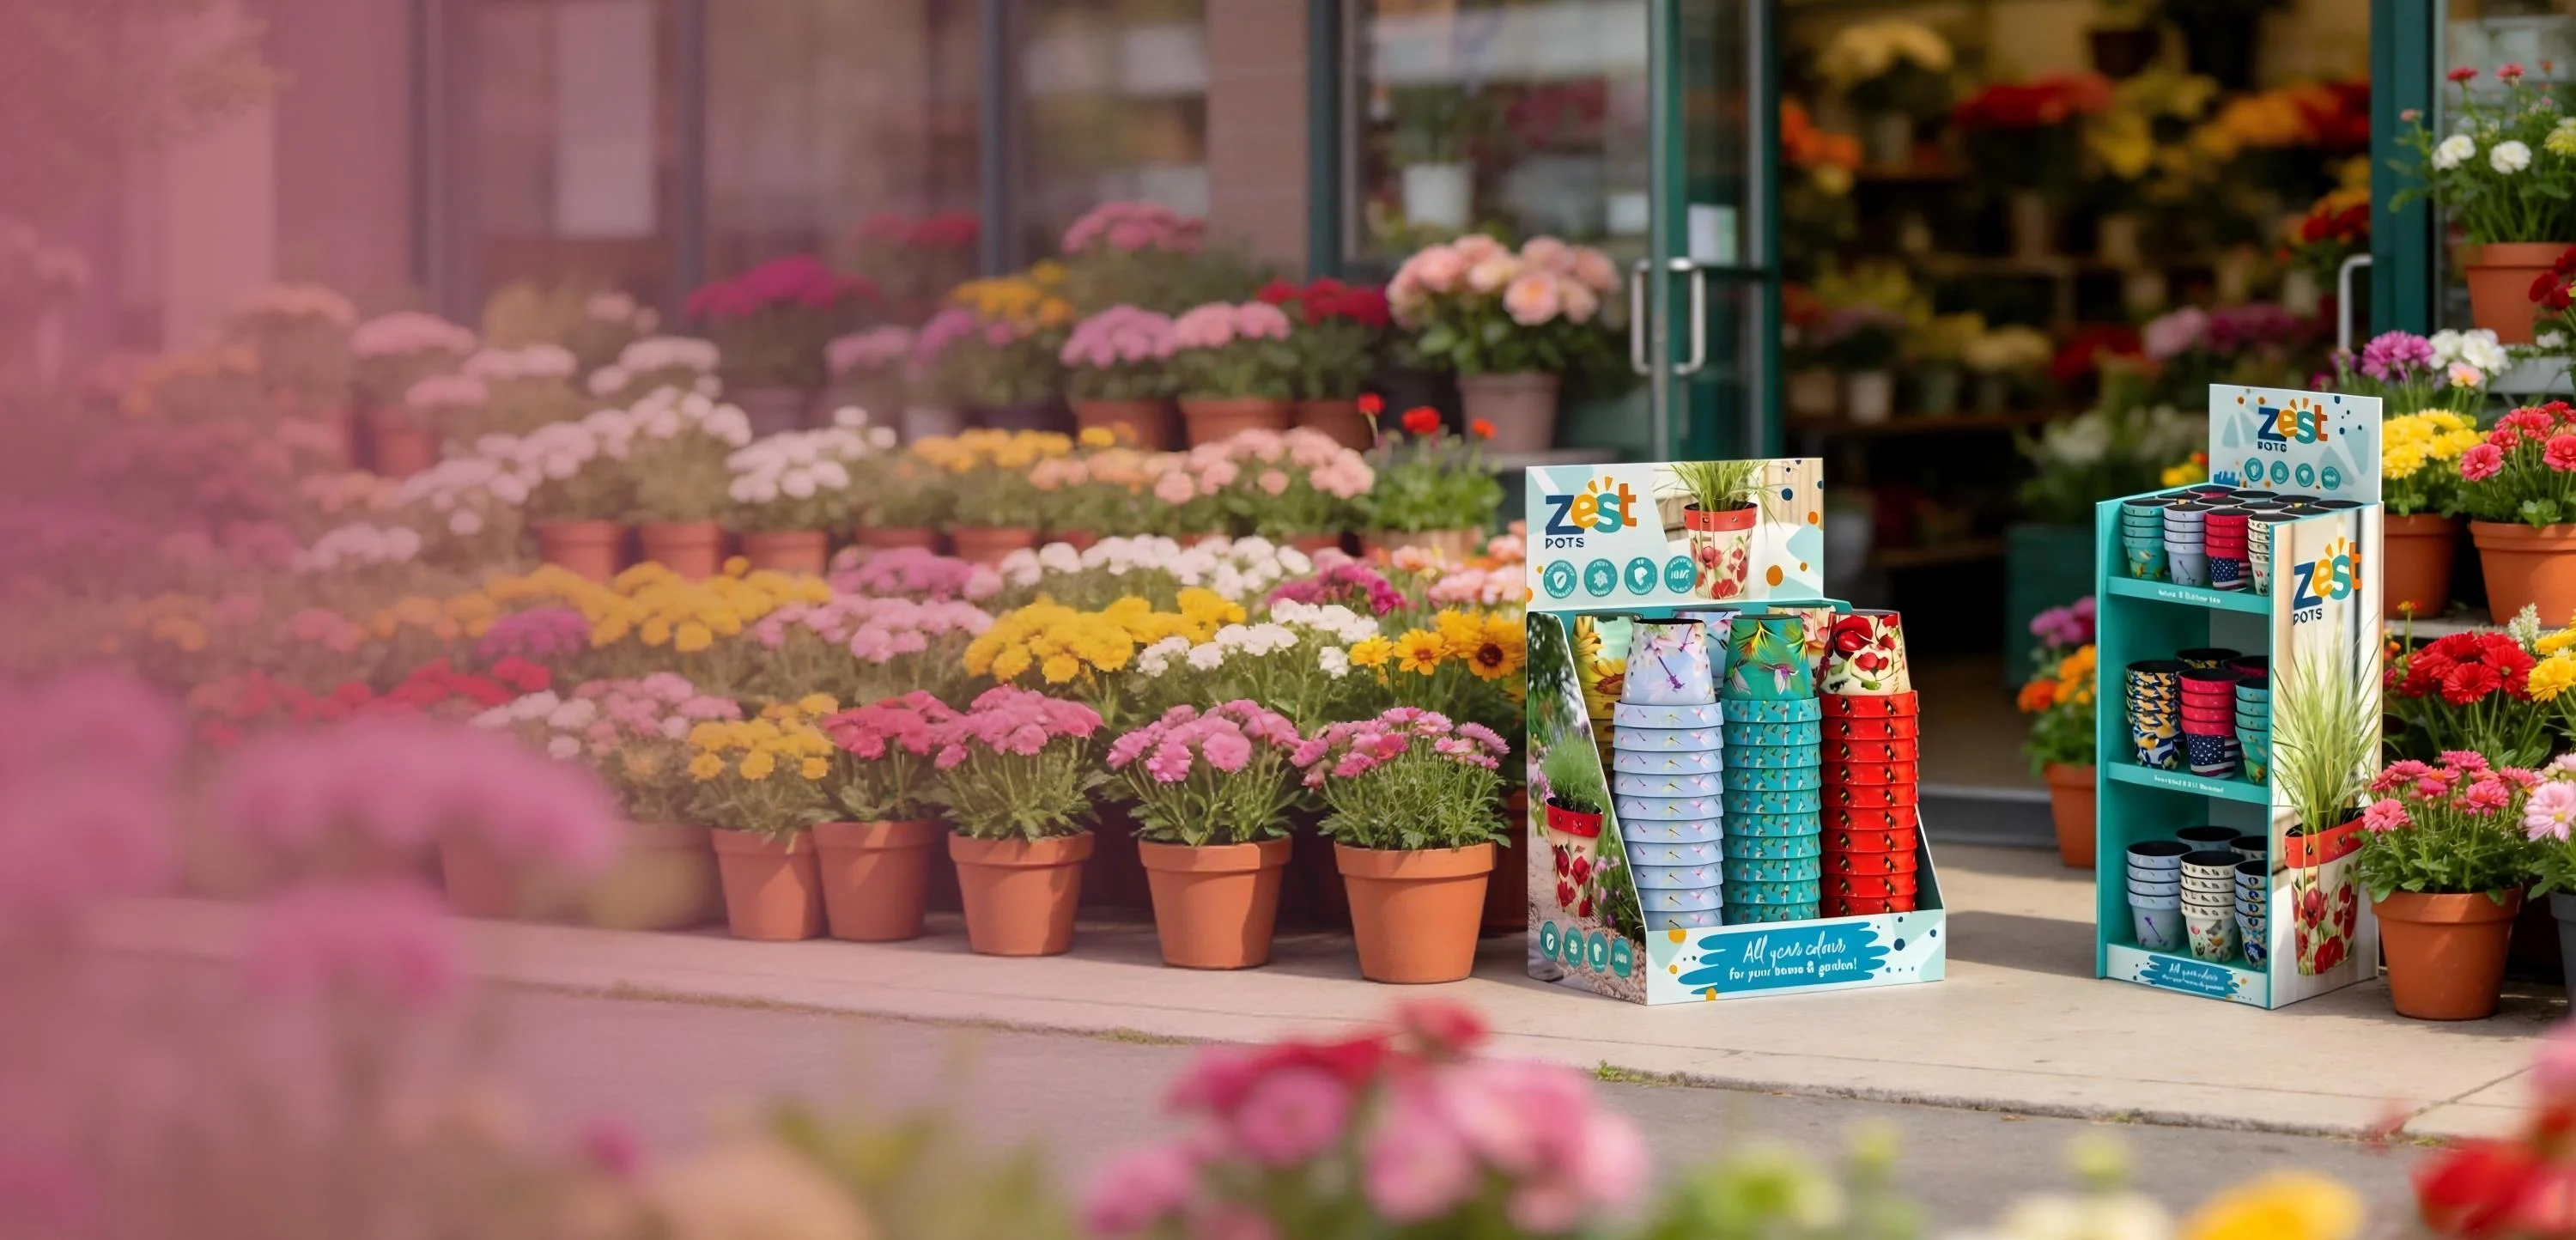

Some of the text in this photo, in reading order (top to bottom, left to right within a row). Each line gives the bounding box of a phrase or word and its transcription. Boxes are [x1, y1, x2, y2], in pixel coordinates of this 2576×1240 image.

[1545, 536, 1584, 550] POTS
[2293, 608, 2324, 626] POTS
[1742, 933, 1769, 964] All
[1728, 966, 1746, 981] for
